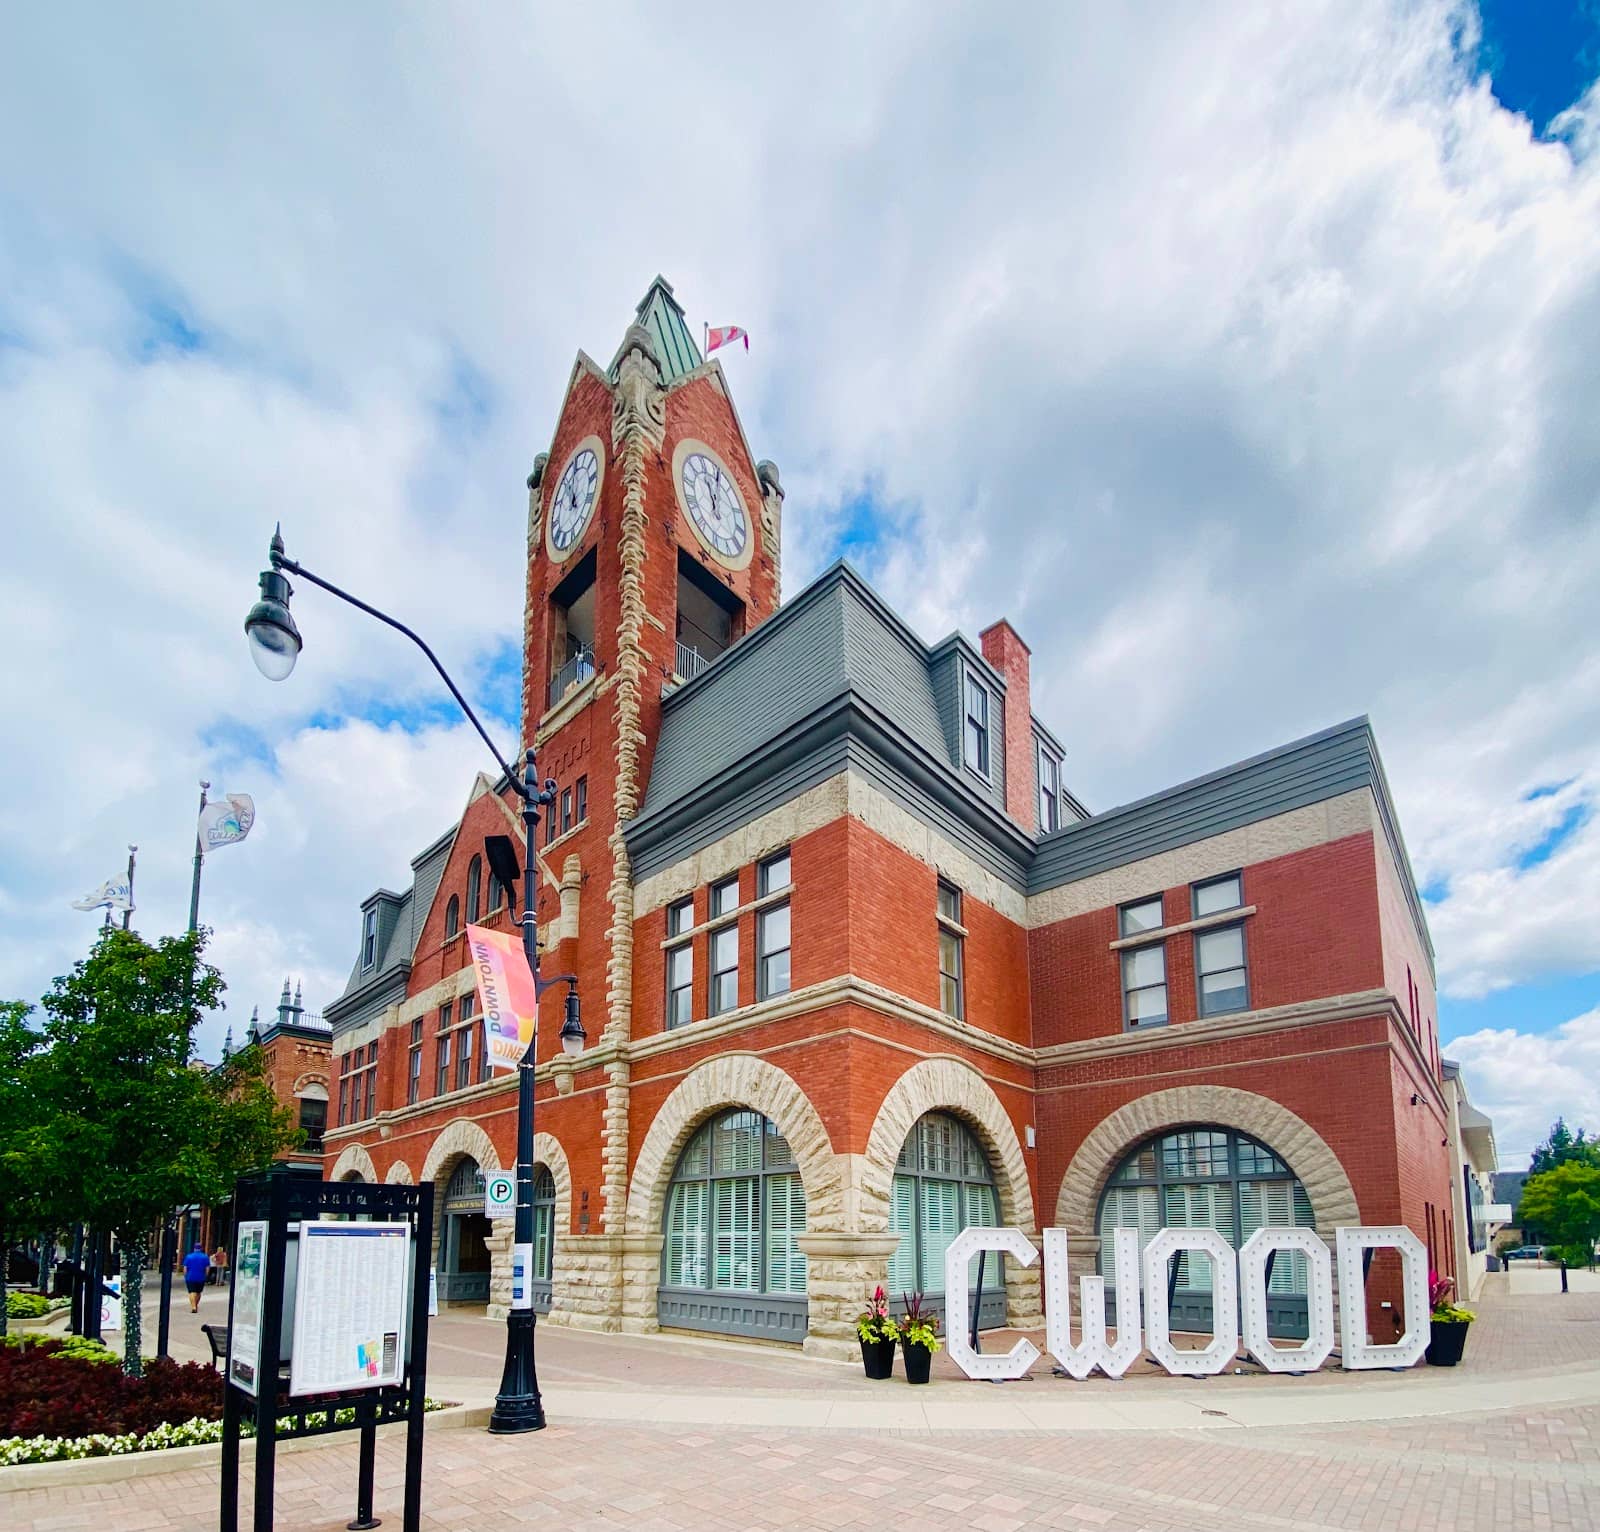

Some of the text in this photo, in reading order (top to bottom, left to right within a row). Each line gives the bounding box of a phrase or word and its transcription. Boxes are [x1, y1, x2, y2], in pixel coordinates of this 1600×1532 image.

[475, 941, 502, 1034] DOWNTOWN
[493, 1039, 525, 1062] DINE
[496, 1184, 508, 1198] P
[945, 1225, 1431, 1380] CWOOD
